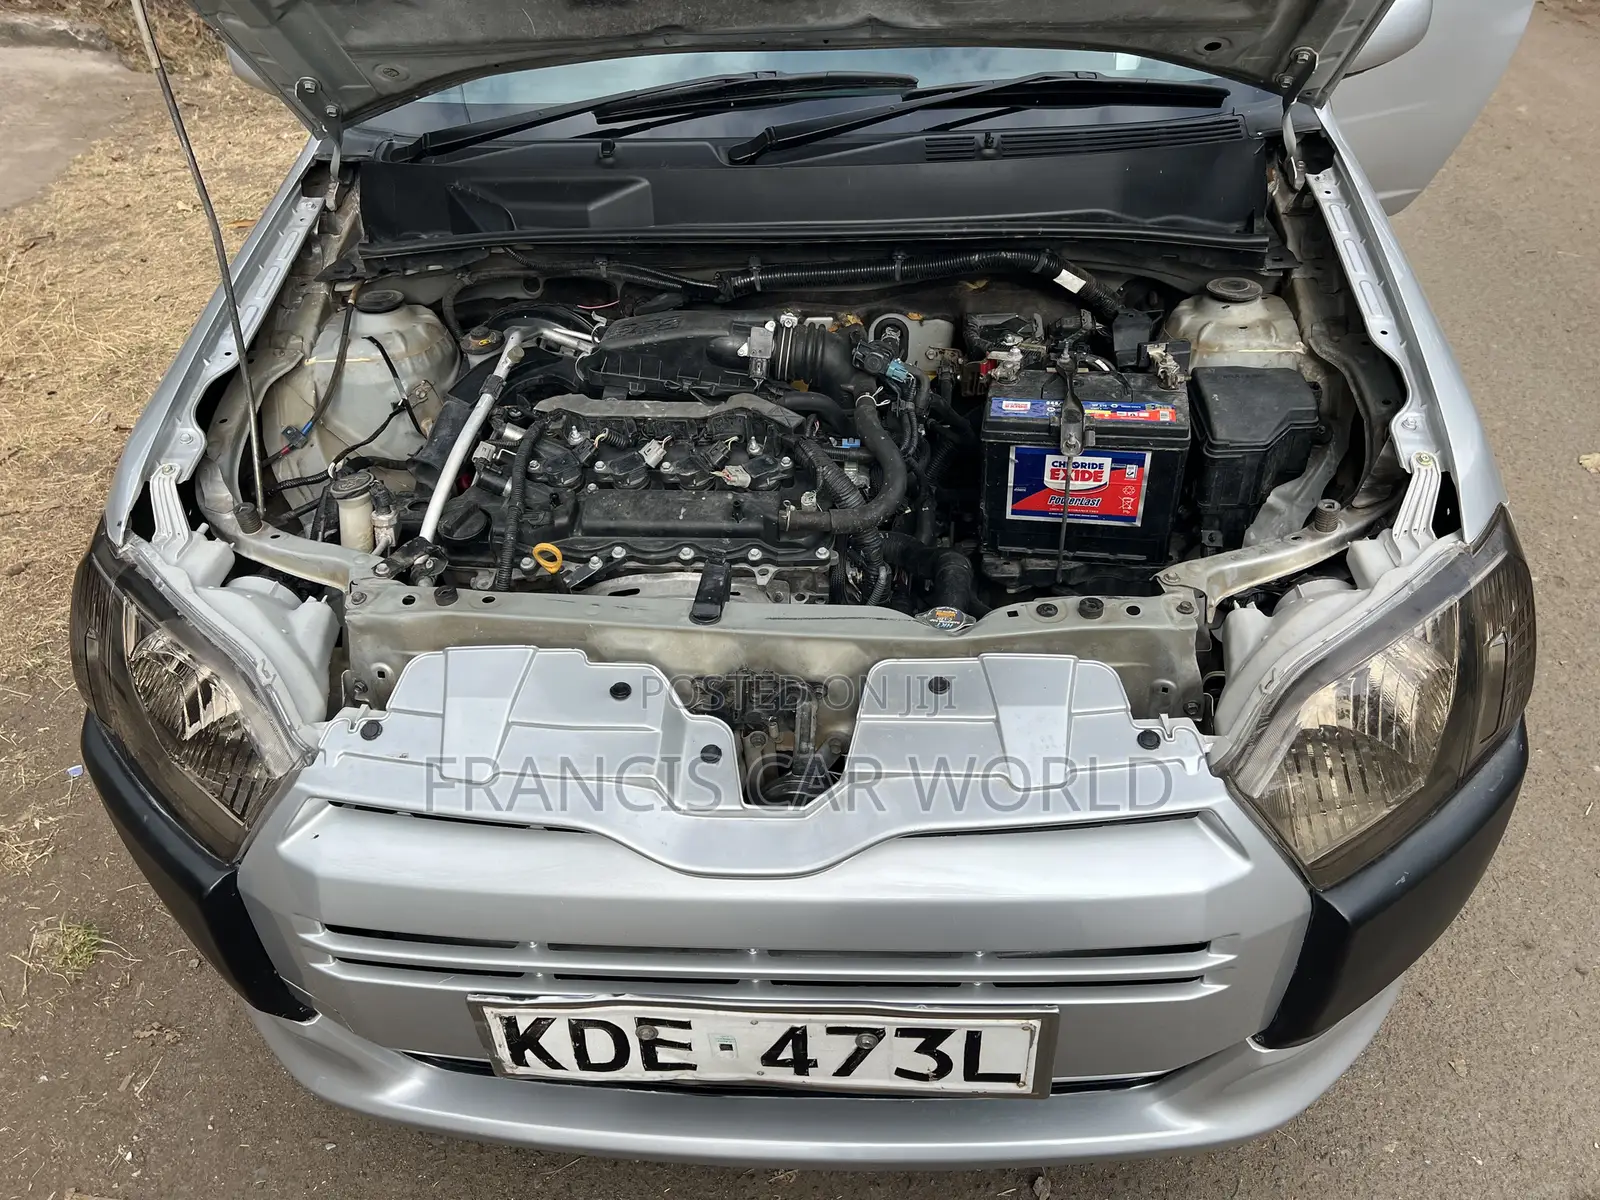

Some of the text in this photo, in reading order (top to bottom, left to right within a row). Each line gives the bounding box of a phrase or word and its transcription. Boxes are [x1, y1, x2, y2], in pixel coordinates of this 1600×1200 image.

[1051, 460, 1105, 470] CHORIDE
[1050, 468, 1105, 482] EXIDE
[501, 1016, 1022, 1082] KDE 473L
